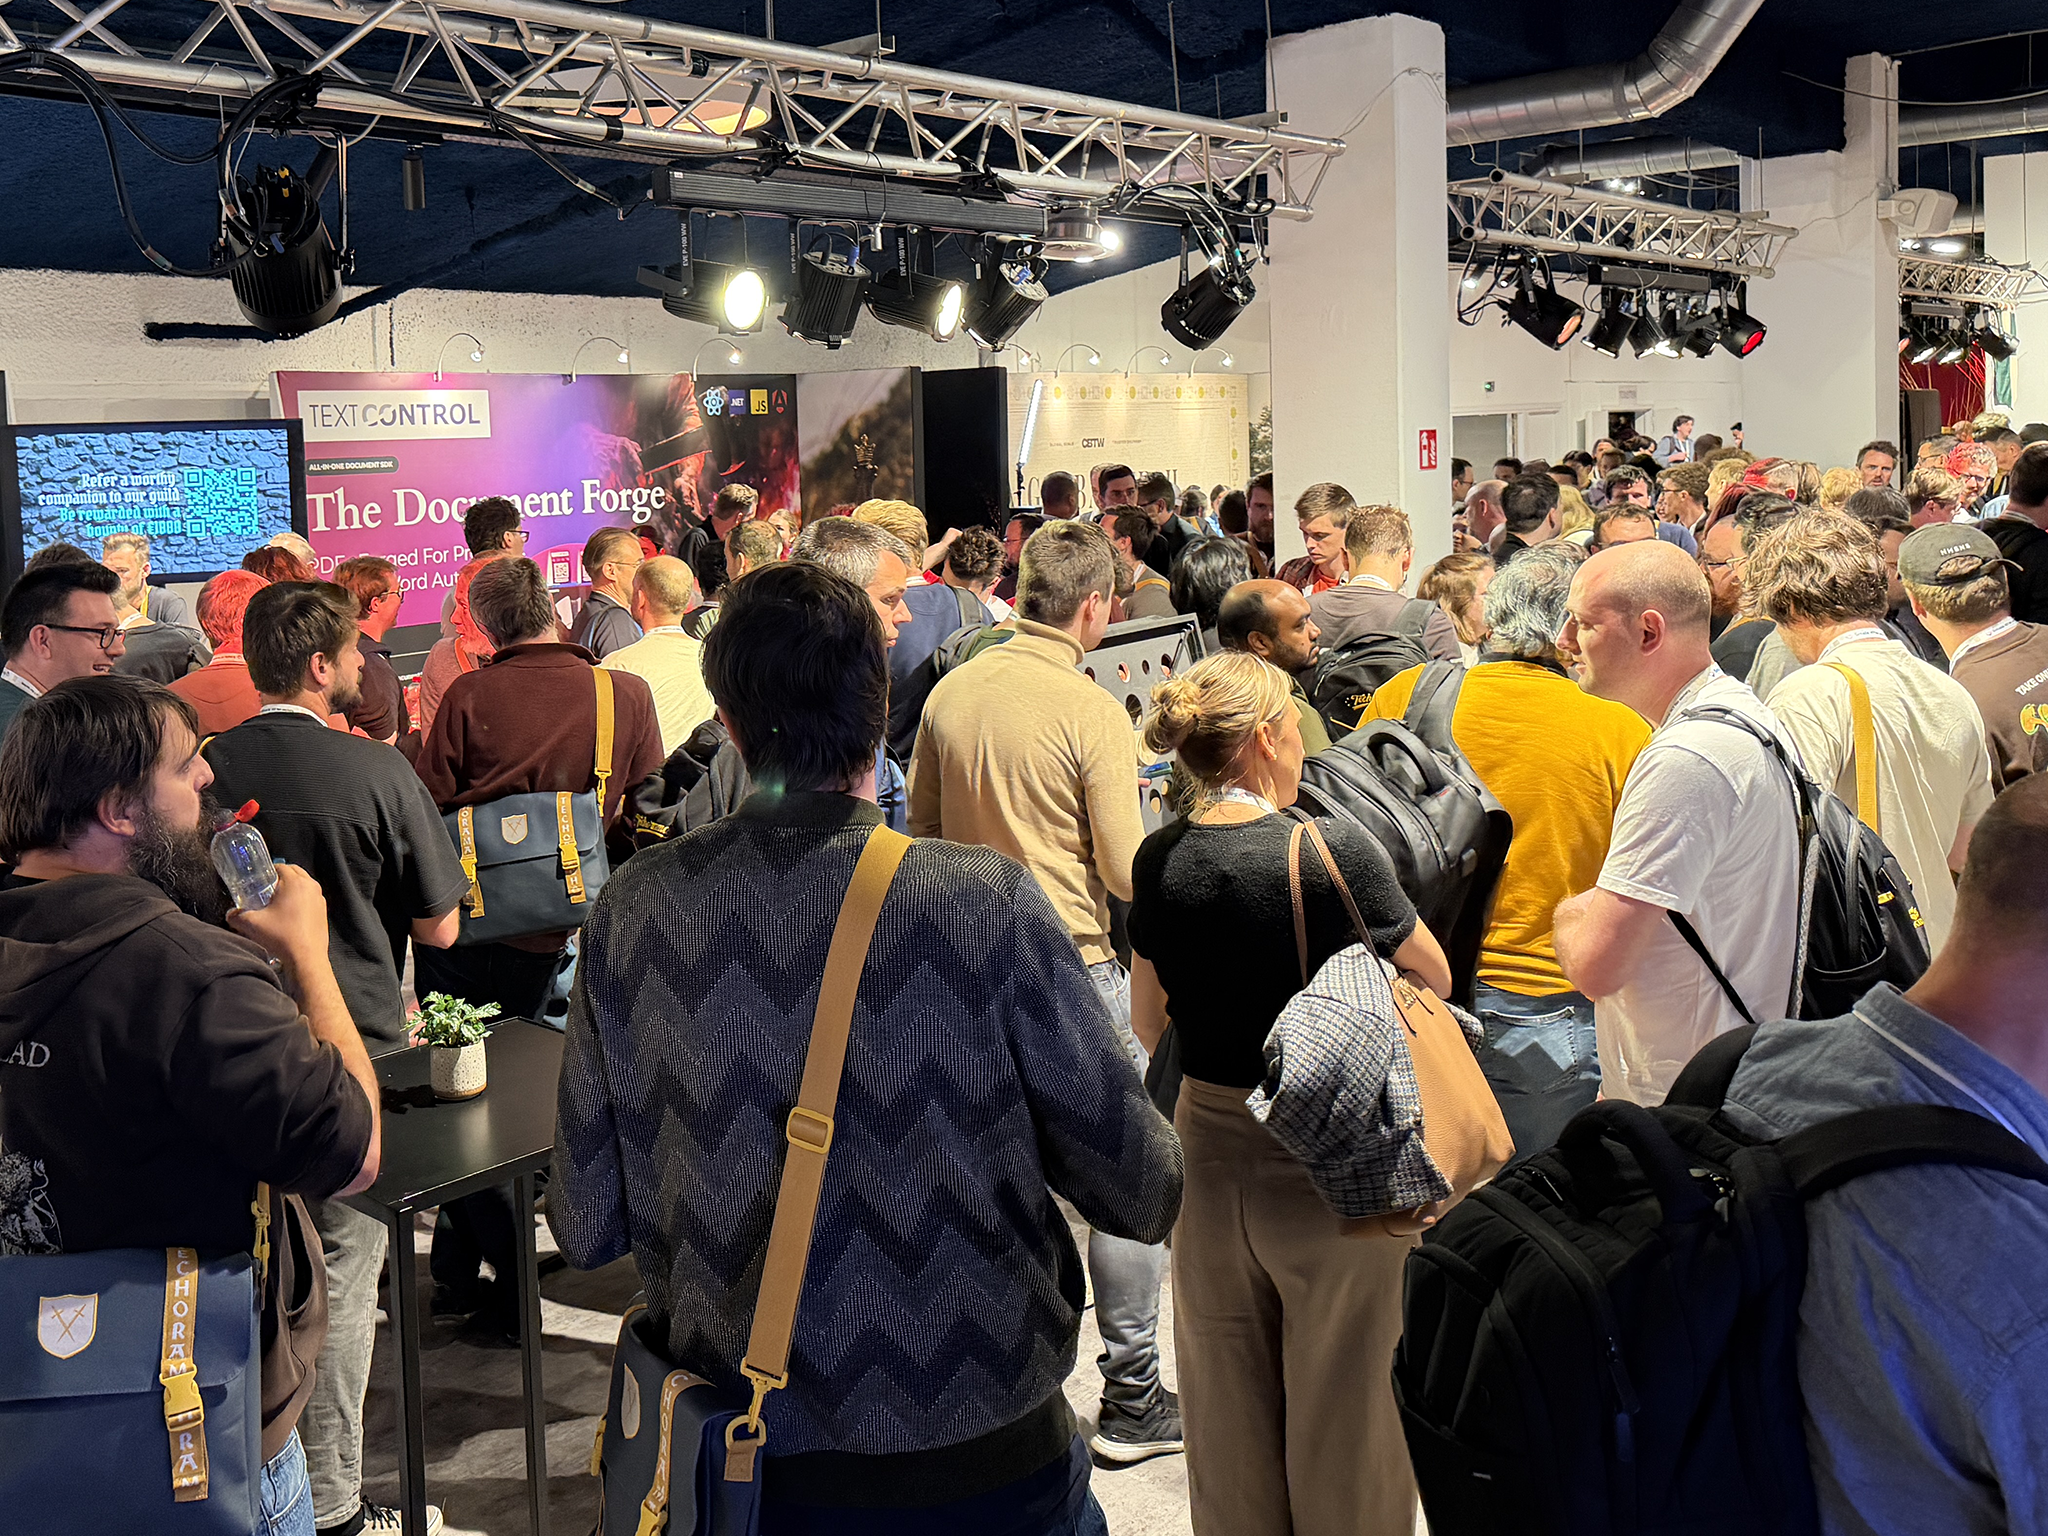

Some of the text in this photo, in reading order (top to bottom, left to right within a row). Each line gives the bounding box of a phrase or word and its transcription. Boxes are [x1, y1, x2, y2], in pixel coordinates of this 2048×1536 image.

[309, 403, 481, 428] TEXT CONTROL
[755, 400, 767, 412] JS
[308, 461, 394, 472] ALL-IN-ONE DOCUMENT SDK
[81, 472, 176, 488] Refer a worthy
[38, 488, 180, 507] companion to our guild
[306, 486, 382, 531] The
[581, 479, 666, 523] Forge
[59, 504, 181, 522] Be rewarded with a
[131, 522, 145, 535] of
[424, 547, 449, 567] For
[398, 570, 427, 592] ord
[2014, 667, 2048, 696] TAKE ON
[0, 1040, 51, 1068] AD
